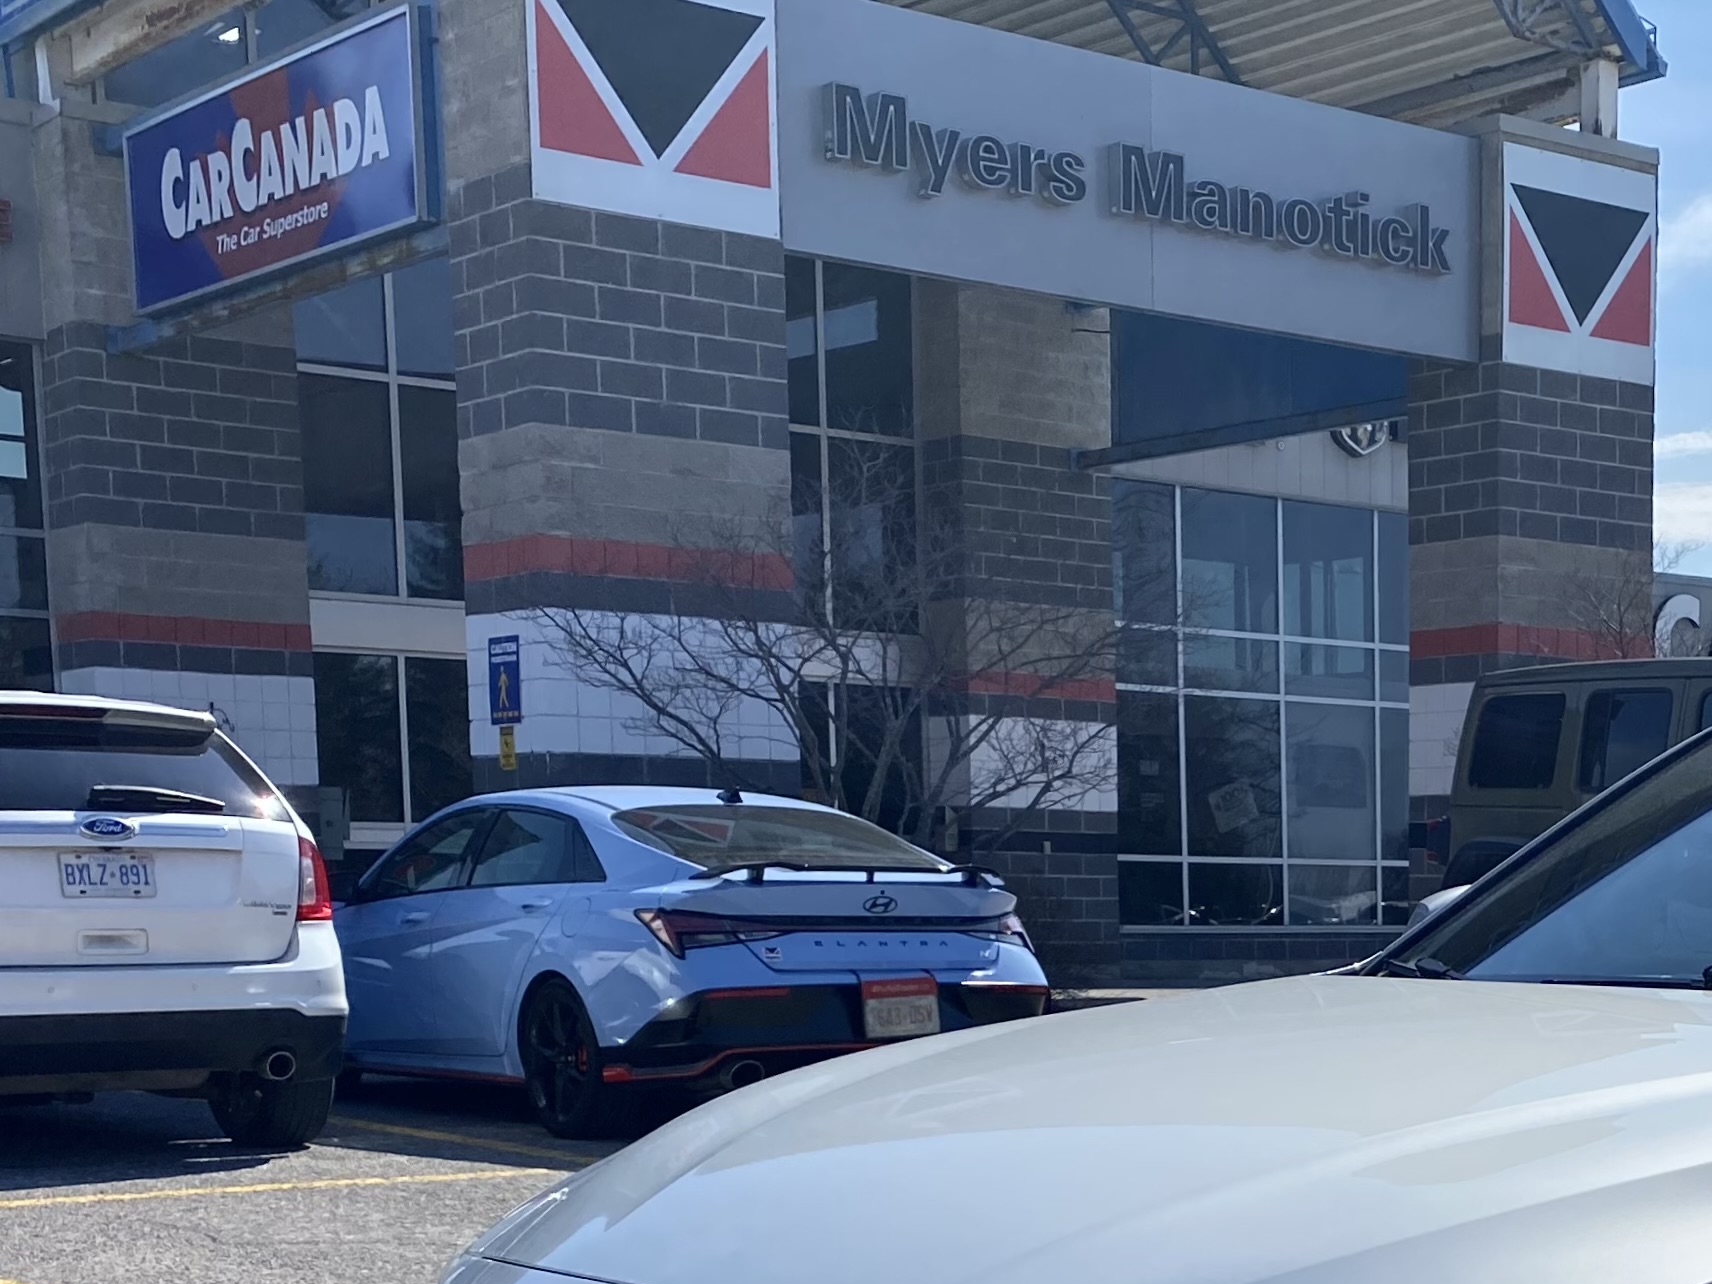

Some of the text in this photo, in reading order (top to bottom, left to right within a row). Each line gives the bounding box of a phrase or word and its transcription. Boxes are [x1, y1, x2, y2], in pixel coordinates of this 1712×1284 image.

[821, 81, 1452, 274] Myers Manotick
[216, 201, 328, 255] The Car Superstore
[93, 820, 123, 833] Ford
[64, 863, 150, 886] BXLZ 891
[814, 940, 949, 948] ELANTRA
